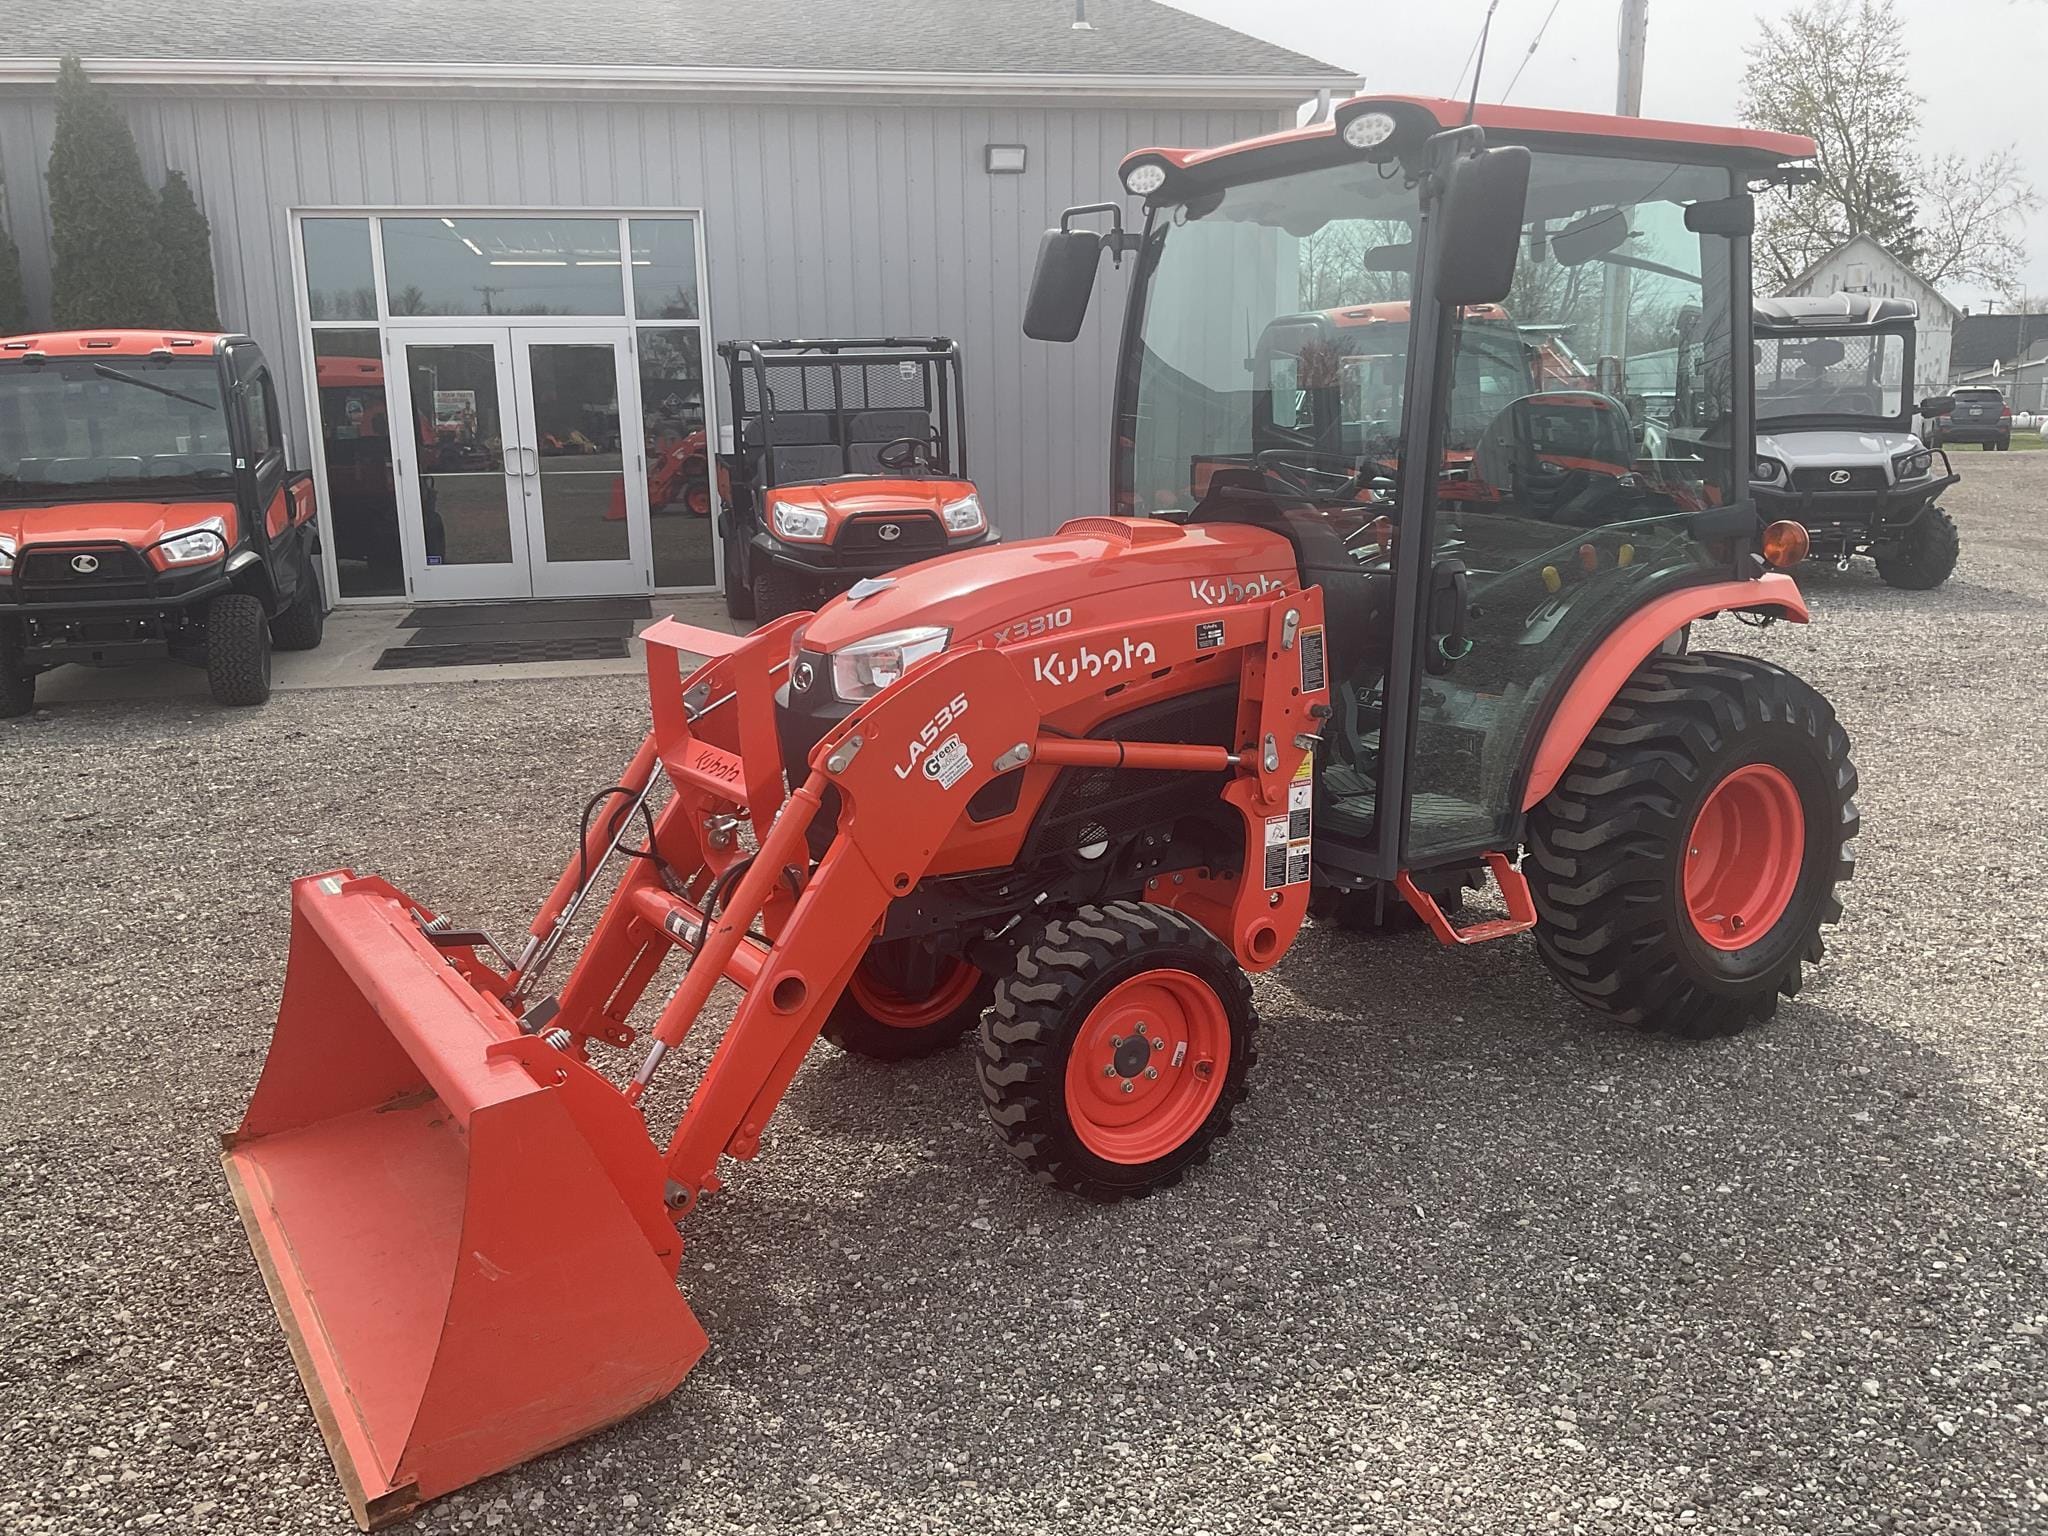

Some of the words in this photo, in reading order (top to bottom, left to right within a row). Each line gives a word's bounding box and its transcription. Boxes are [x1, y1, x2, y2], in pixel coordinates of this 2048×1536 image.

[1033, 637, 1156, 686] Kubota
[894, 692, 968, 779] LA535
[695, 750, 740, 782] Kubota
[925, 741, 957, 776] Green
